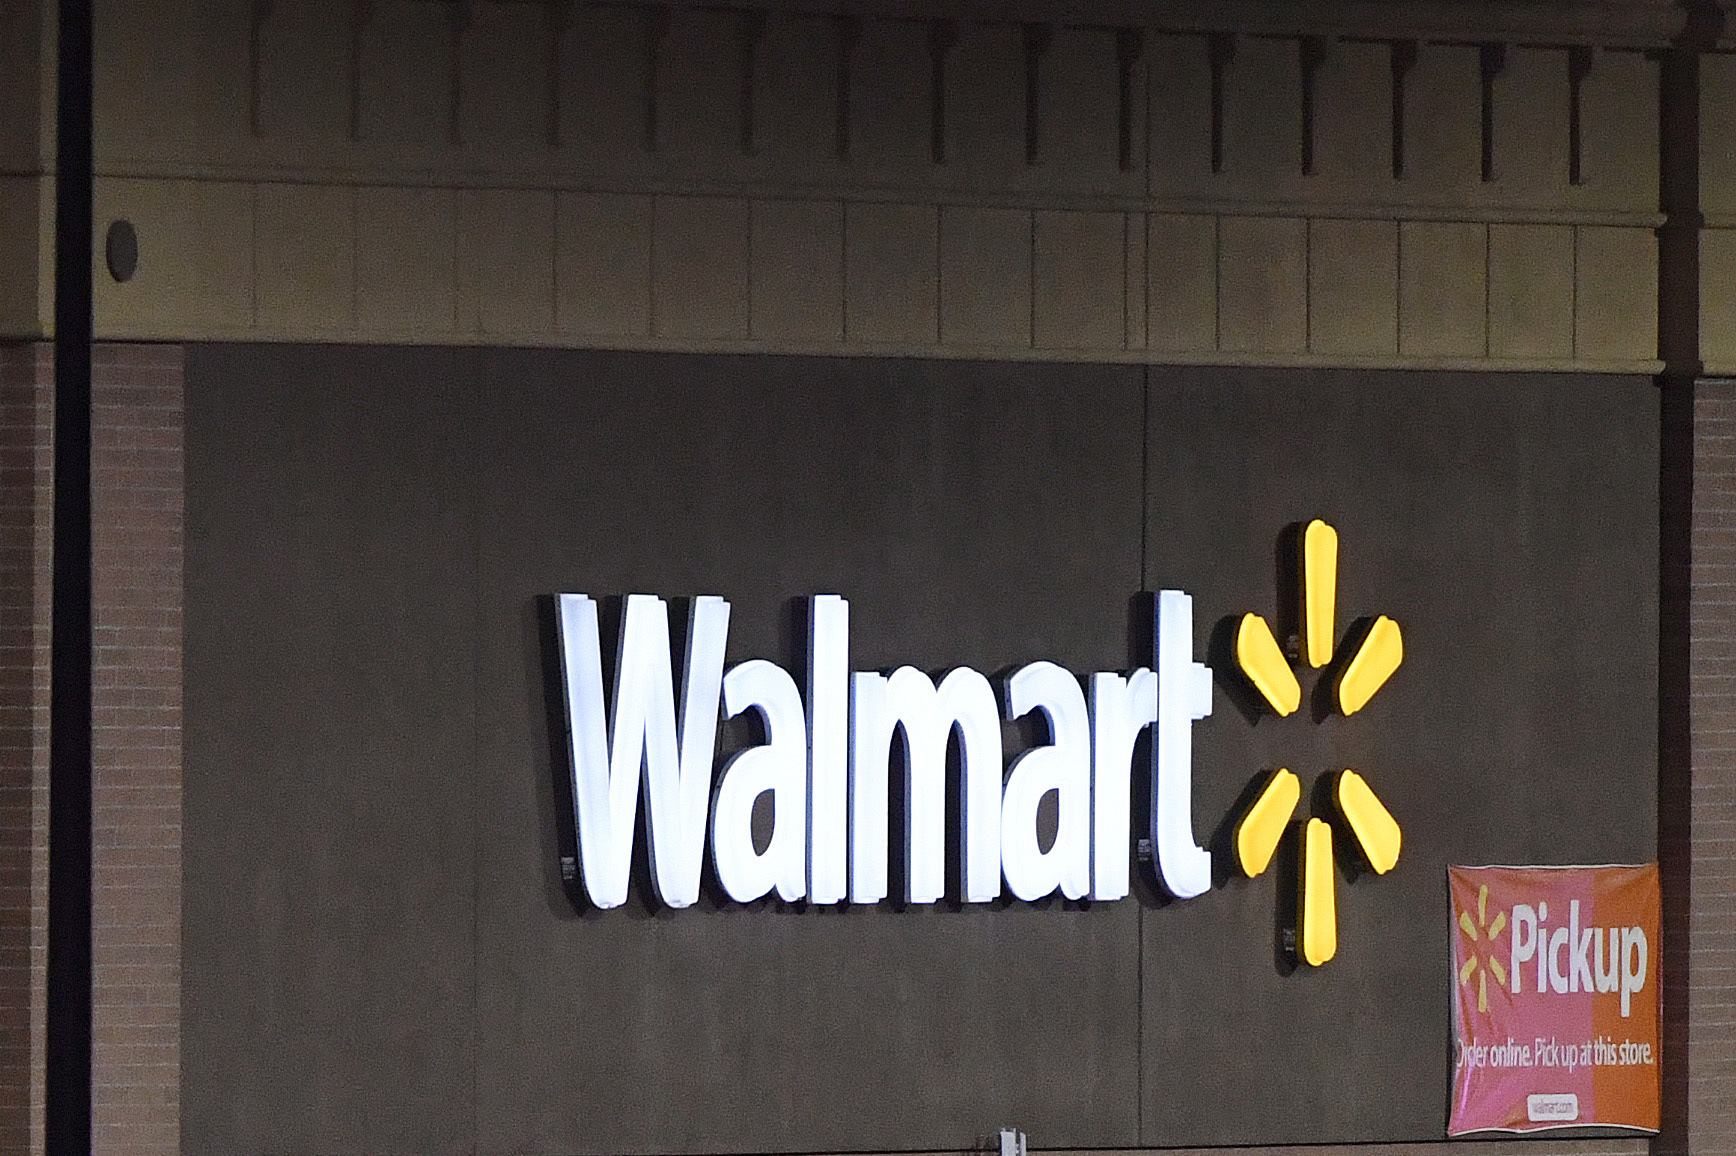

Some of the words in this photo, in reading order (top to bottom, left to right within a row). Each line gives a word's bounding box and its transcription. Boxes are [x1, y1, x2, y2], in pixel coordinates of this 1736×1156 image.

[555, 588, 1213, 910] Walmart
[1510, 899, 1648, 1018] Pickup
[1489, 1036, 1533, 1068] online.
[1534, 1036, 1559, 1068] Pick
[1561, 1044, 1578, 1073] up
[1580, 1040, 1593, 1067] at
[1593, 1036, 1617, 1066] this
[1618, 1037, 1654, 1066] store.
